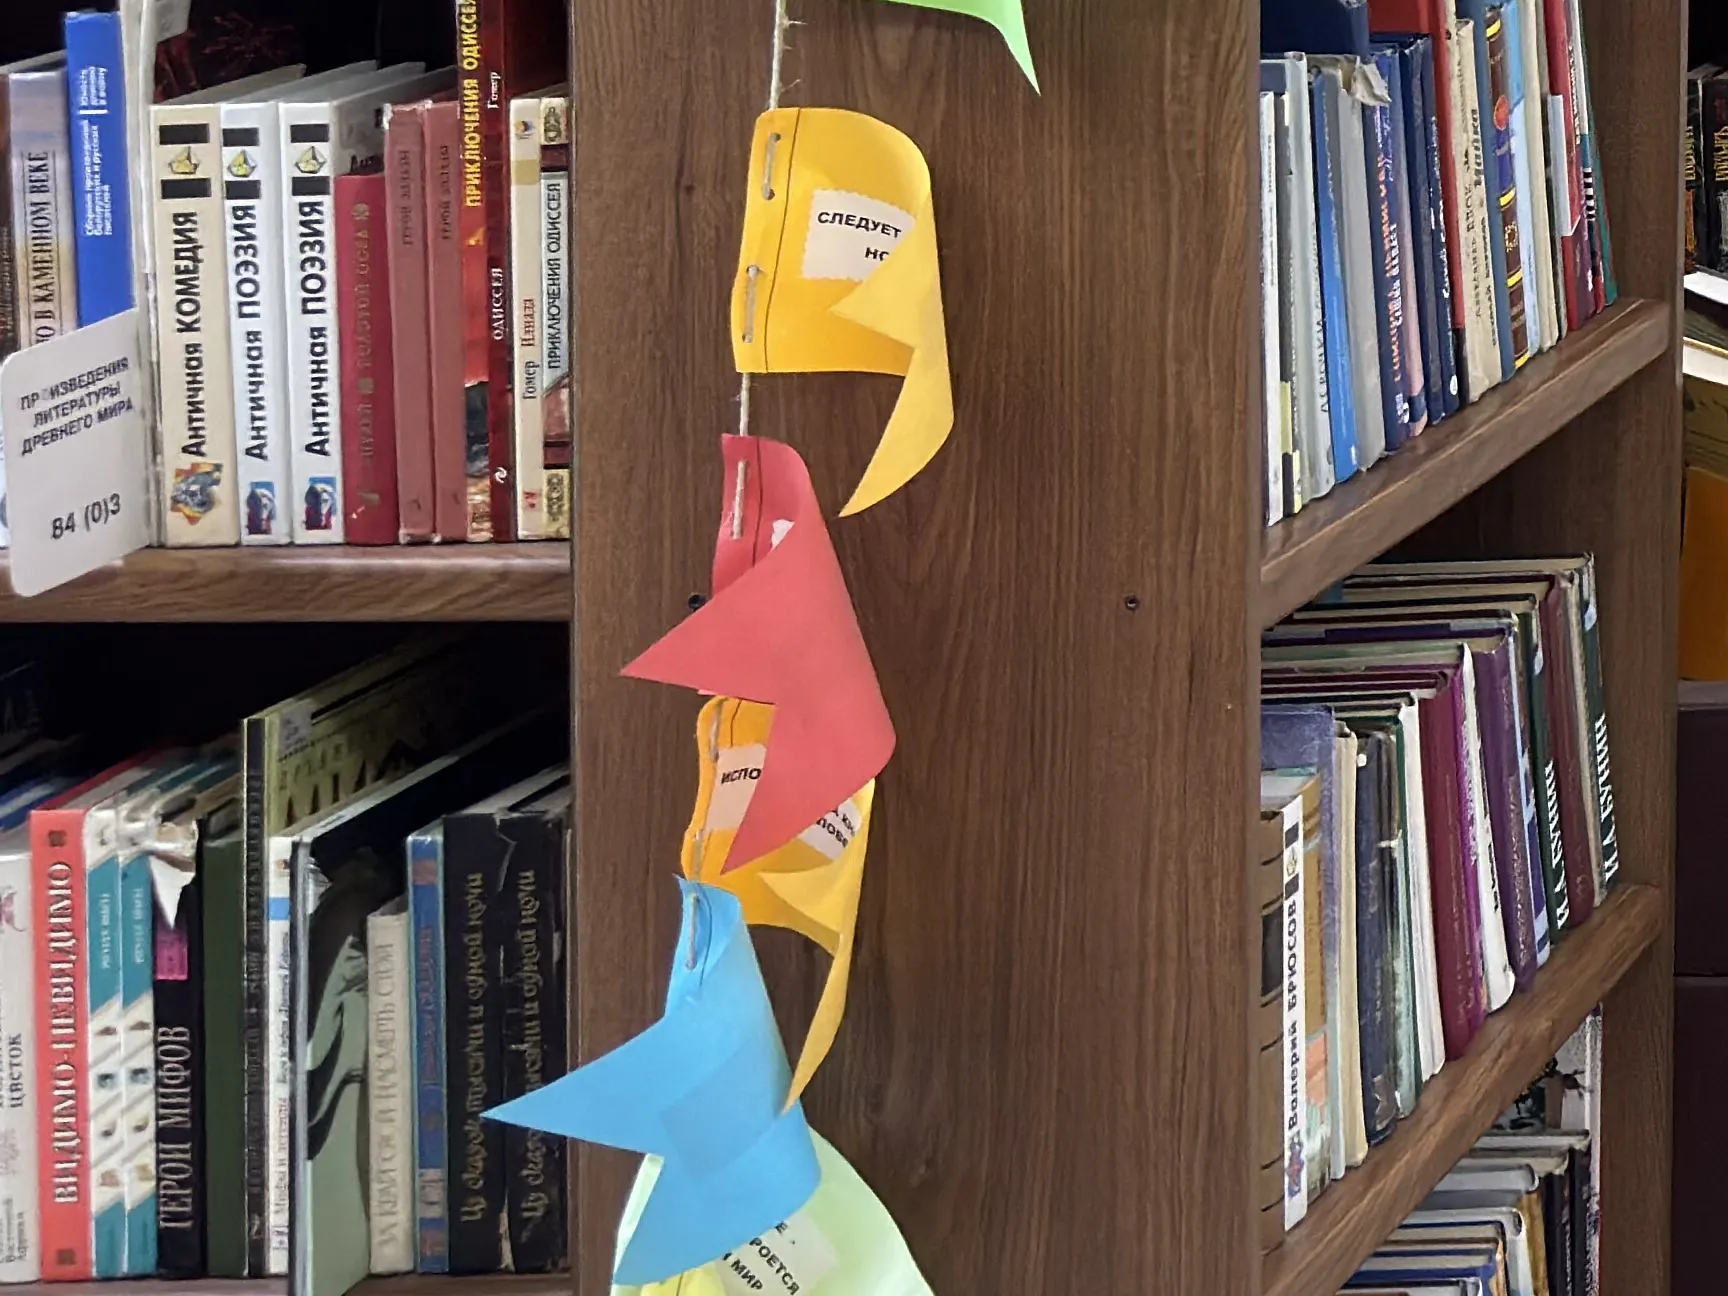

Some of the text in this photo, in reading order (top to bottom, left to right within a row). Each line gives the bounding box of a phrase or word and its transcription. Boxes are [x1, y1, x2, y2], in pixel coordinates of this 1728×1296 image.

[462, 78, 482, 208] ПРИКЛЮЧЕНИЯ
[817, 210, 903, 240] СЛЕДУЕТ
[175, 209, 208, 459] Античная КОМЕДИЯ
[238, 203, 271, 462] Античная ПОЭЗИЯ
[297, 200, 331, 459] Античная ПОЭЗИЯ
[492, 266, 505, 341] ОДИССЕЯ
[547, 182, 562, 370] ПРИКЛЮЧЕНИЯ ОДИССЕЯ
[21, 398, 135, 457] ДРЕВНЕГО МИРА
[31, 380, 122, 429] ЛИТЕРАТУРЫ
[49, 494, 122, 541] 84 (0)3
[45, 861, 82, 1204] ВИДИМО-НЕВИДИМО
[1284, 898, 1304, 1131] Валерий БРЮСОВ
[157, 1026, 193, 1229] ГЕРОИ МИФОВ
